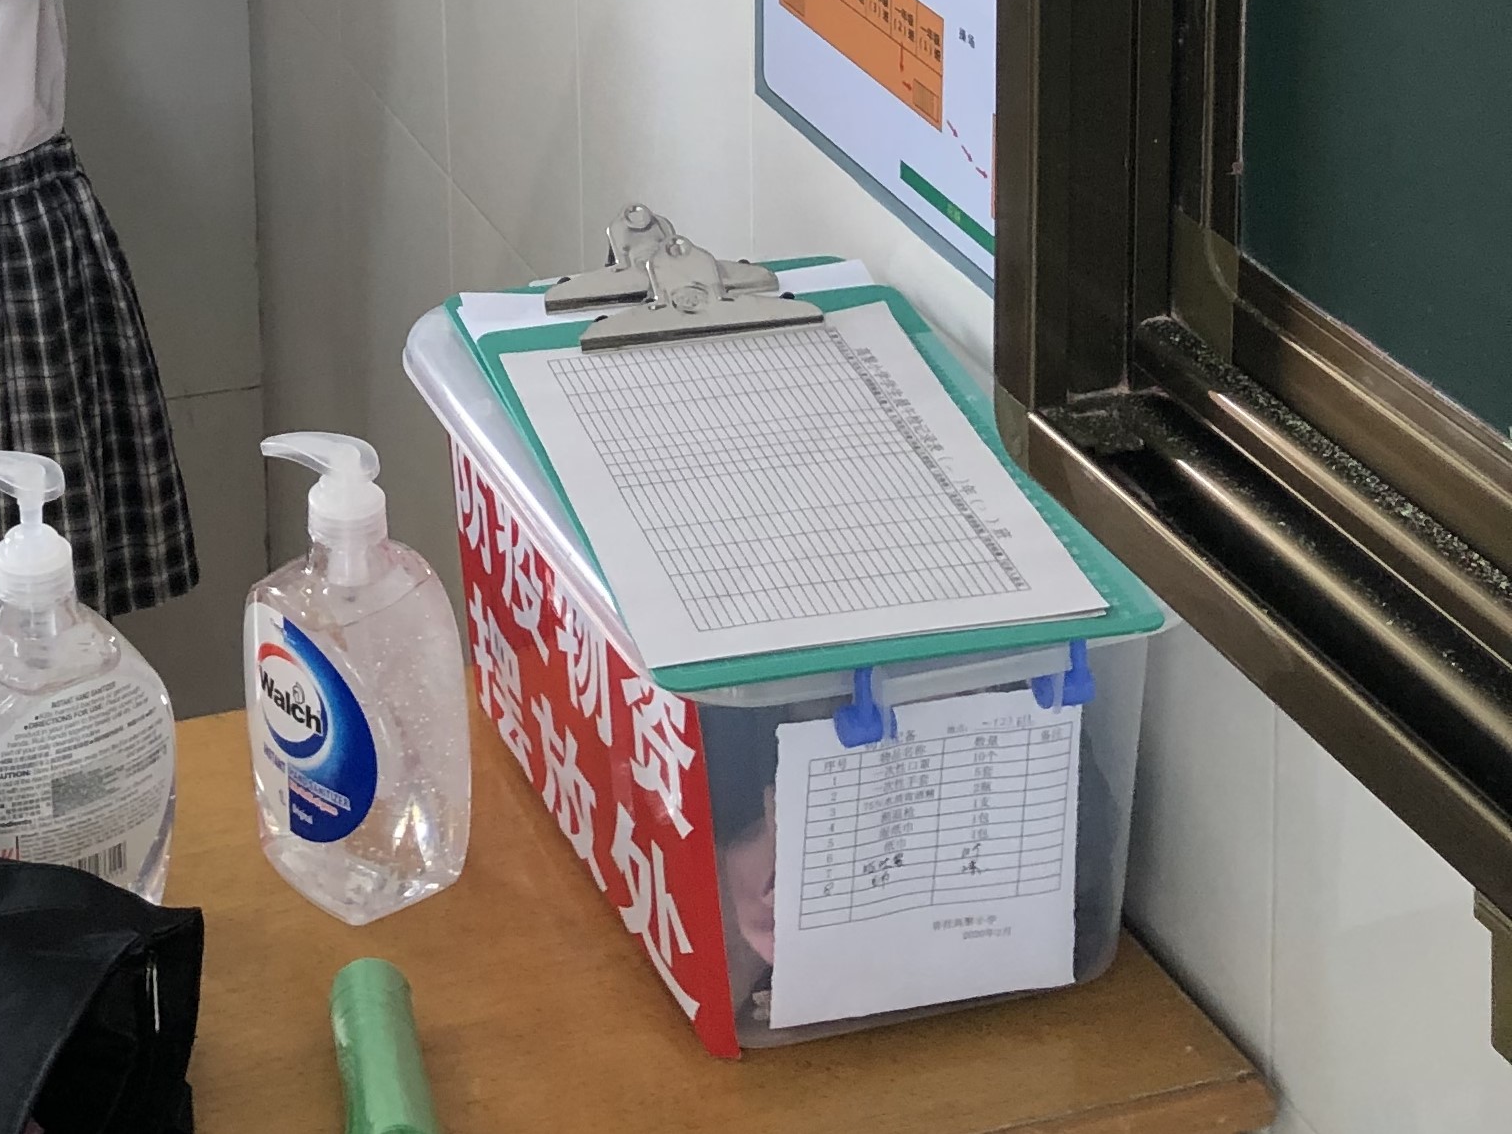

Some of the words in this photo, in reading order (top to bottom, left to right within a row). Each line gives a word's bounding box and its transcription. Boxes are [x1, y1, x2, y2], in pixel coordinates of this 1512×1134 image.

[453, 436, 696, 840] 防疫物资
[73, 709, 89, 718] FOR
[259, 665, 322, 734] Walch
[823, 758, 847, 772] 序号
[879, 745, 926, 764] 物品名称
[974, 735, 999, 747] 数量
[873, 759, 931, 777] 一次性口罩
[972, 751, 998, 763] 10个
[469, 582, 701, 1021] 摆放处
[873, 775, 929, 794] 一次性手套
